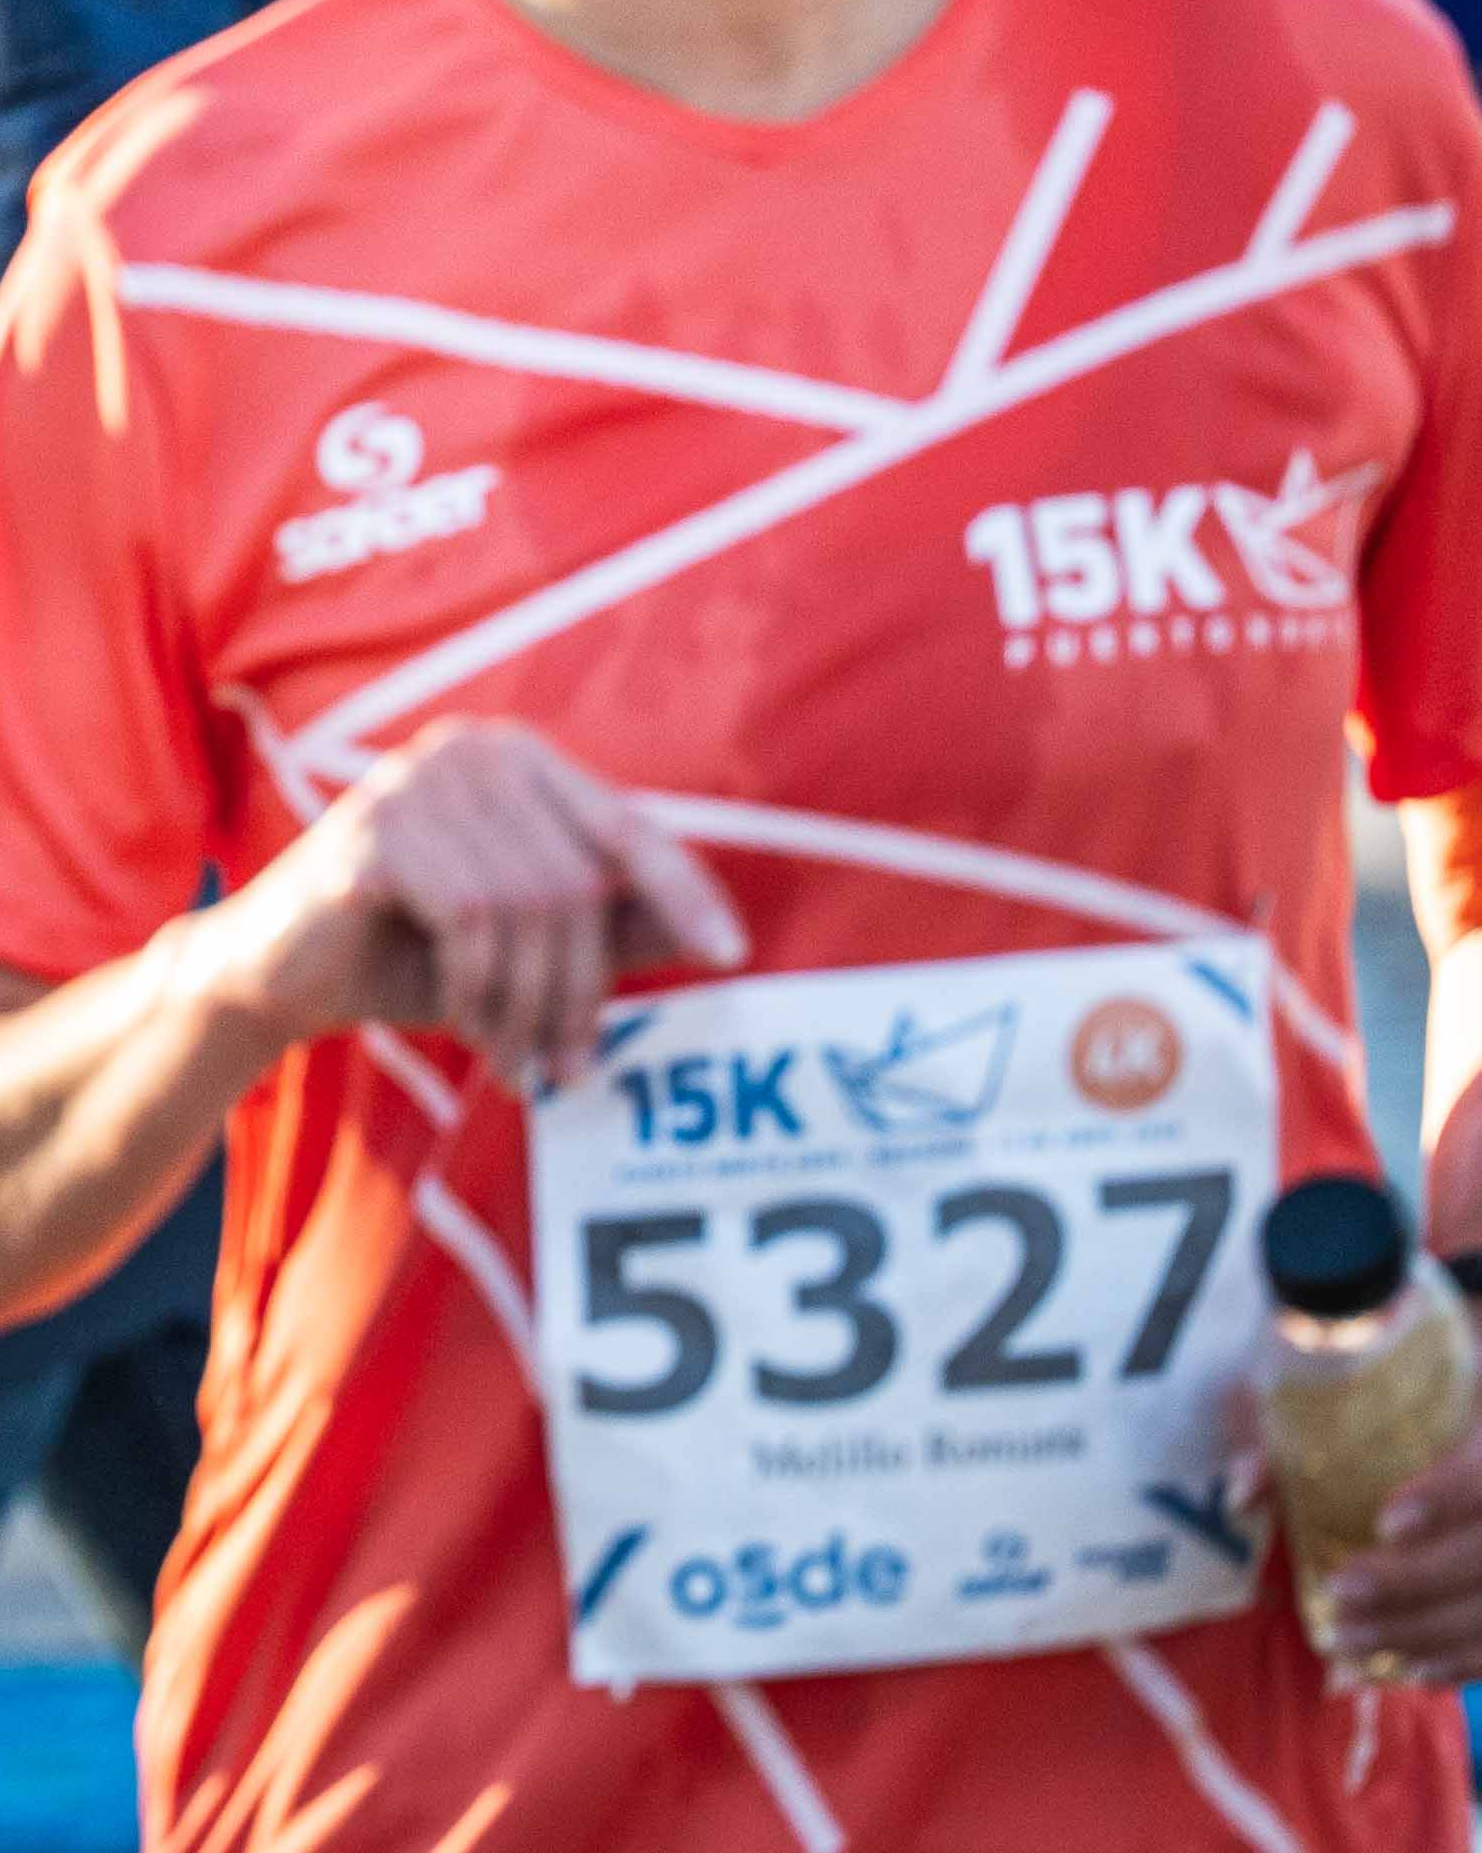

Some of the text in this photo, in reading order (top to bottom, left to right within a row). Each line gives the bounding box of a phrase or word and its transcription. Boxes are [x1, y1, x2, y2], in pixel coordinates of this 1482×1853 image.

[964, 483, 1225, 630] 15K
[616, 1047, 805, 1149] 15K
[576, 1167, 1237, 1418] 5327
[668, 1530, 909, 1624] osde
